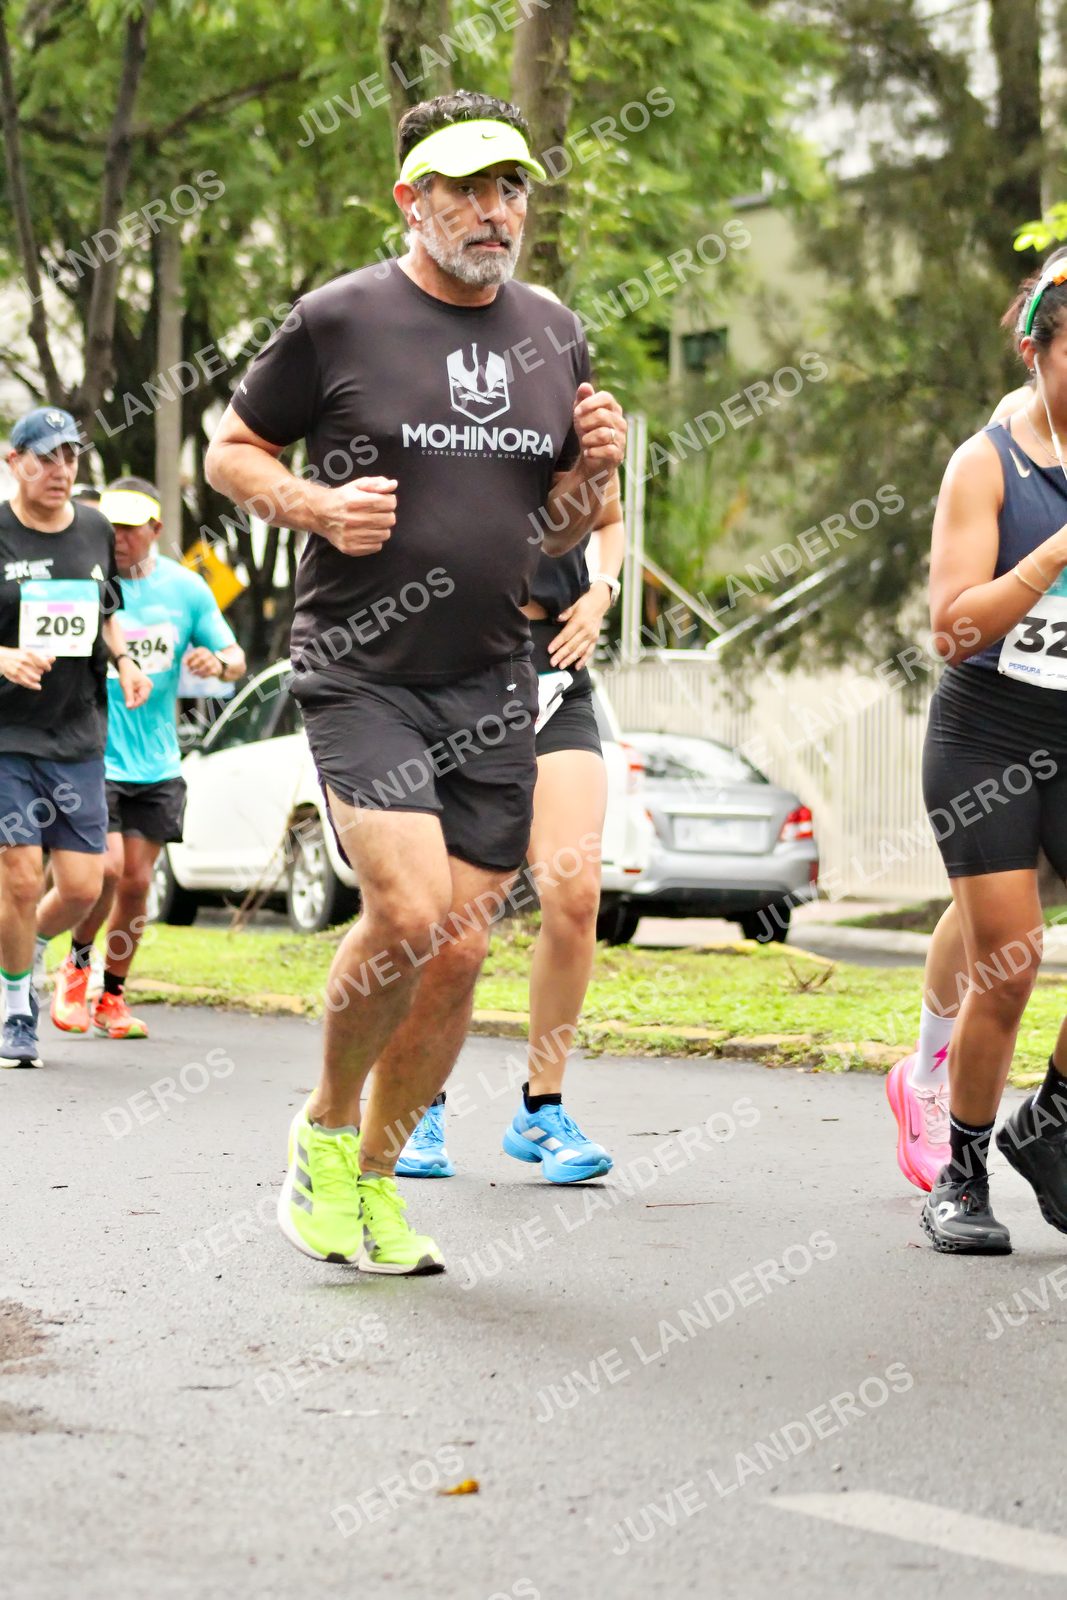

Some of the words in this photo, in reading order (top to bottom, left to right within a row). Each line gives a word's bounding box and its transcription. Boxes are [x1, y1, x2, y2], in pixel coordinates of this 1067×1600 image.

[401, 423, 554, 459] MOHINORA
[36, 616, 86, 637] 209
[1008, 662, 1041, 674] PERDURA
